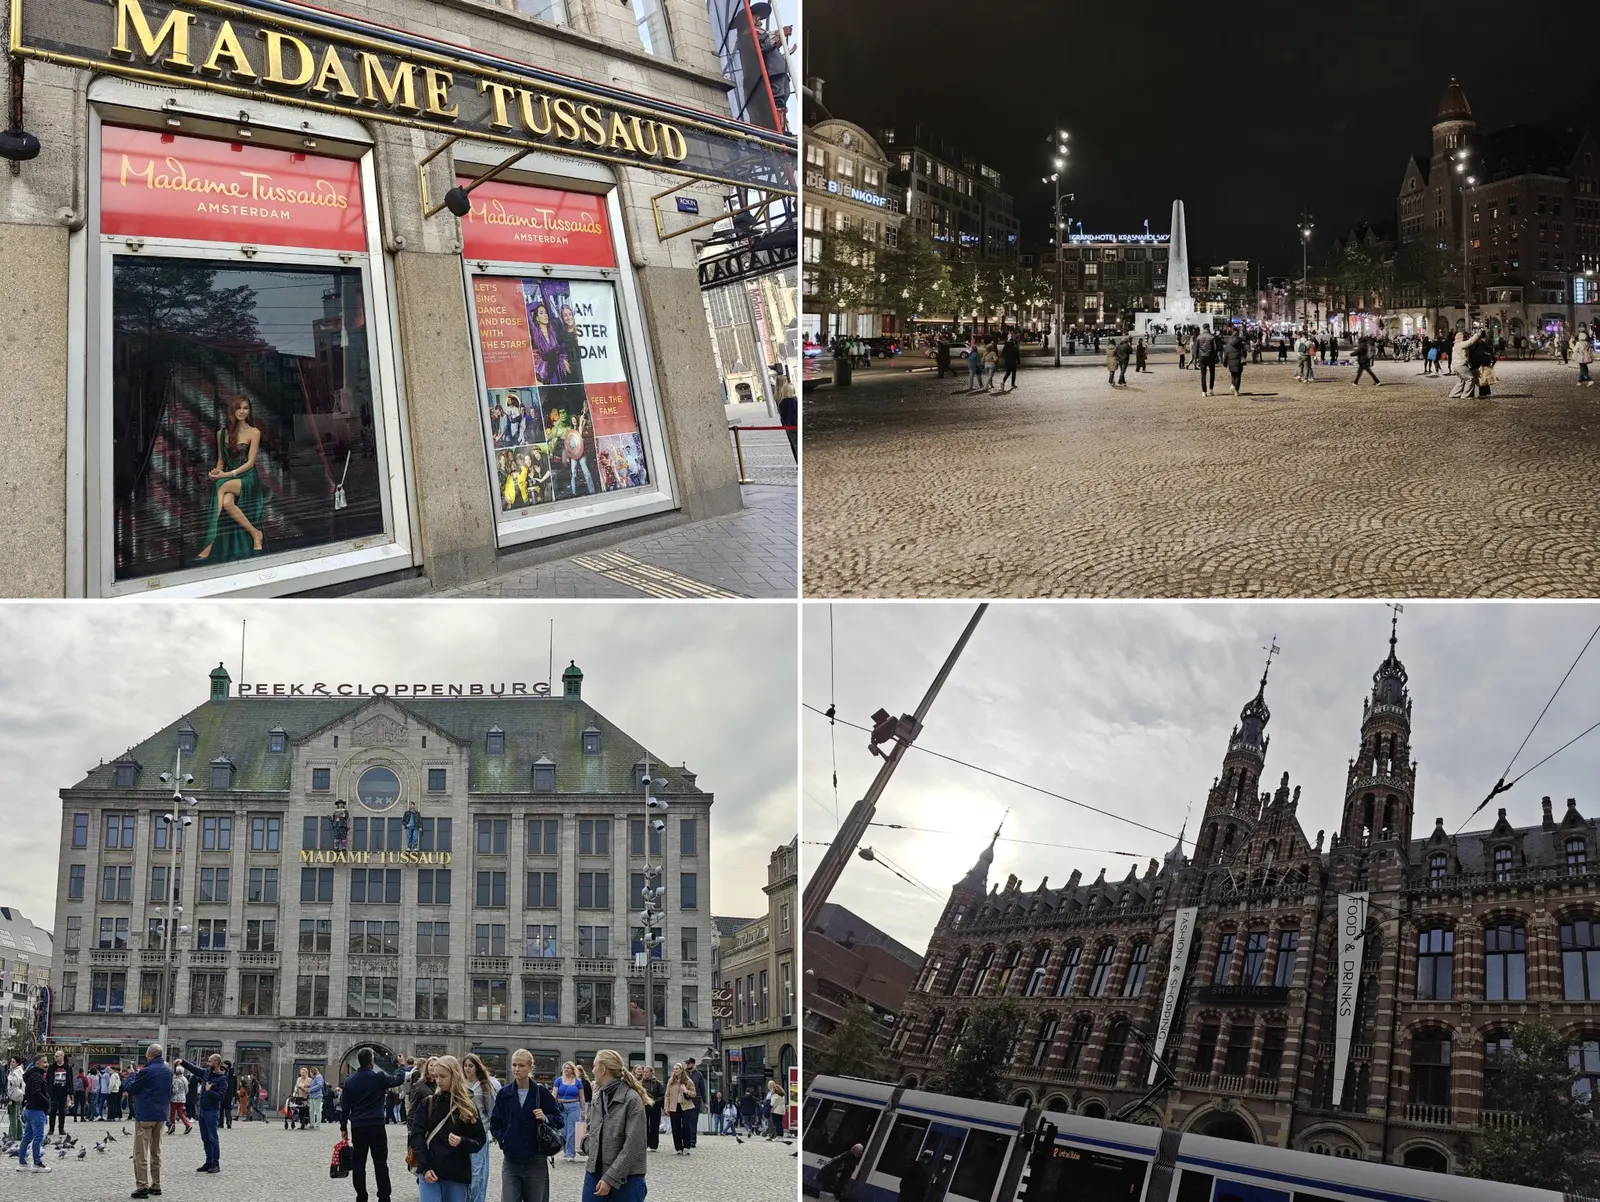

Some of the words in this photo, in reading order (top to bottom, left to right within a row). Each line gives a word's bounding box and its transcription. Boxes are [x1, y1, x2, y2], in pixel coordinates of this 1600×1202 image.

[110, 0, 459, 119] MADAME
[478, 80, 688, 163] TUSSAUD
[120, 154, 248, 199] Madame
[239, 171, 348, 210] Tussauds
[197, 202, 290, 220] AMSTERDAM
[468, 199, 542, 228] Madame
[535, 208, 603, 235] Tussauds
[514, 233, 569, 245] AMSTERDAM
[474, 283, 498, 292] LET'S
[475, 295, 497, 303] SING
[478, 306, 508, 314] DANCE
[480, 318, 498, 326] AND
[500, 317, 523, 326] POSE
[480, 329, 504, 337] WITH
[576, 324, 608, 338] STER
[482, 341, 499, 349] THE
[500, 340, 528, 349] STARS
[580, 345, 608, 359] DAM
[591, 396, 608, 405] FEEL
[608, 395, 623, 404] THE
[599, 407, 618, 416] FAME
[299, 850, 372, 864] MADAME
[380, 851, 452, 864] TUSSAUD
[1346, 897, 1359, 937] FOOD
[1175, 912, 1190, 960] FASHION
[1344, 943, 1356, 953] &
[1212, 987, 1270, 996] SHOPPING
[1339, 960, 1354, 1017] DRINKS
[1159, 978, 1179, 1040] SHOPPING
[41, 1045, 77, 1053] MADAME
[81, 1046, 116, 1054] TUSSAUD
